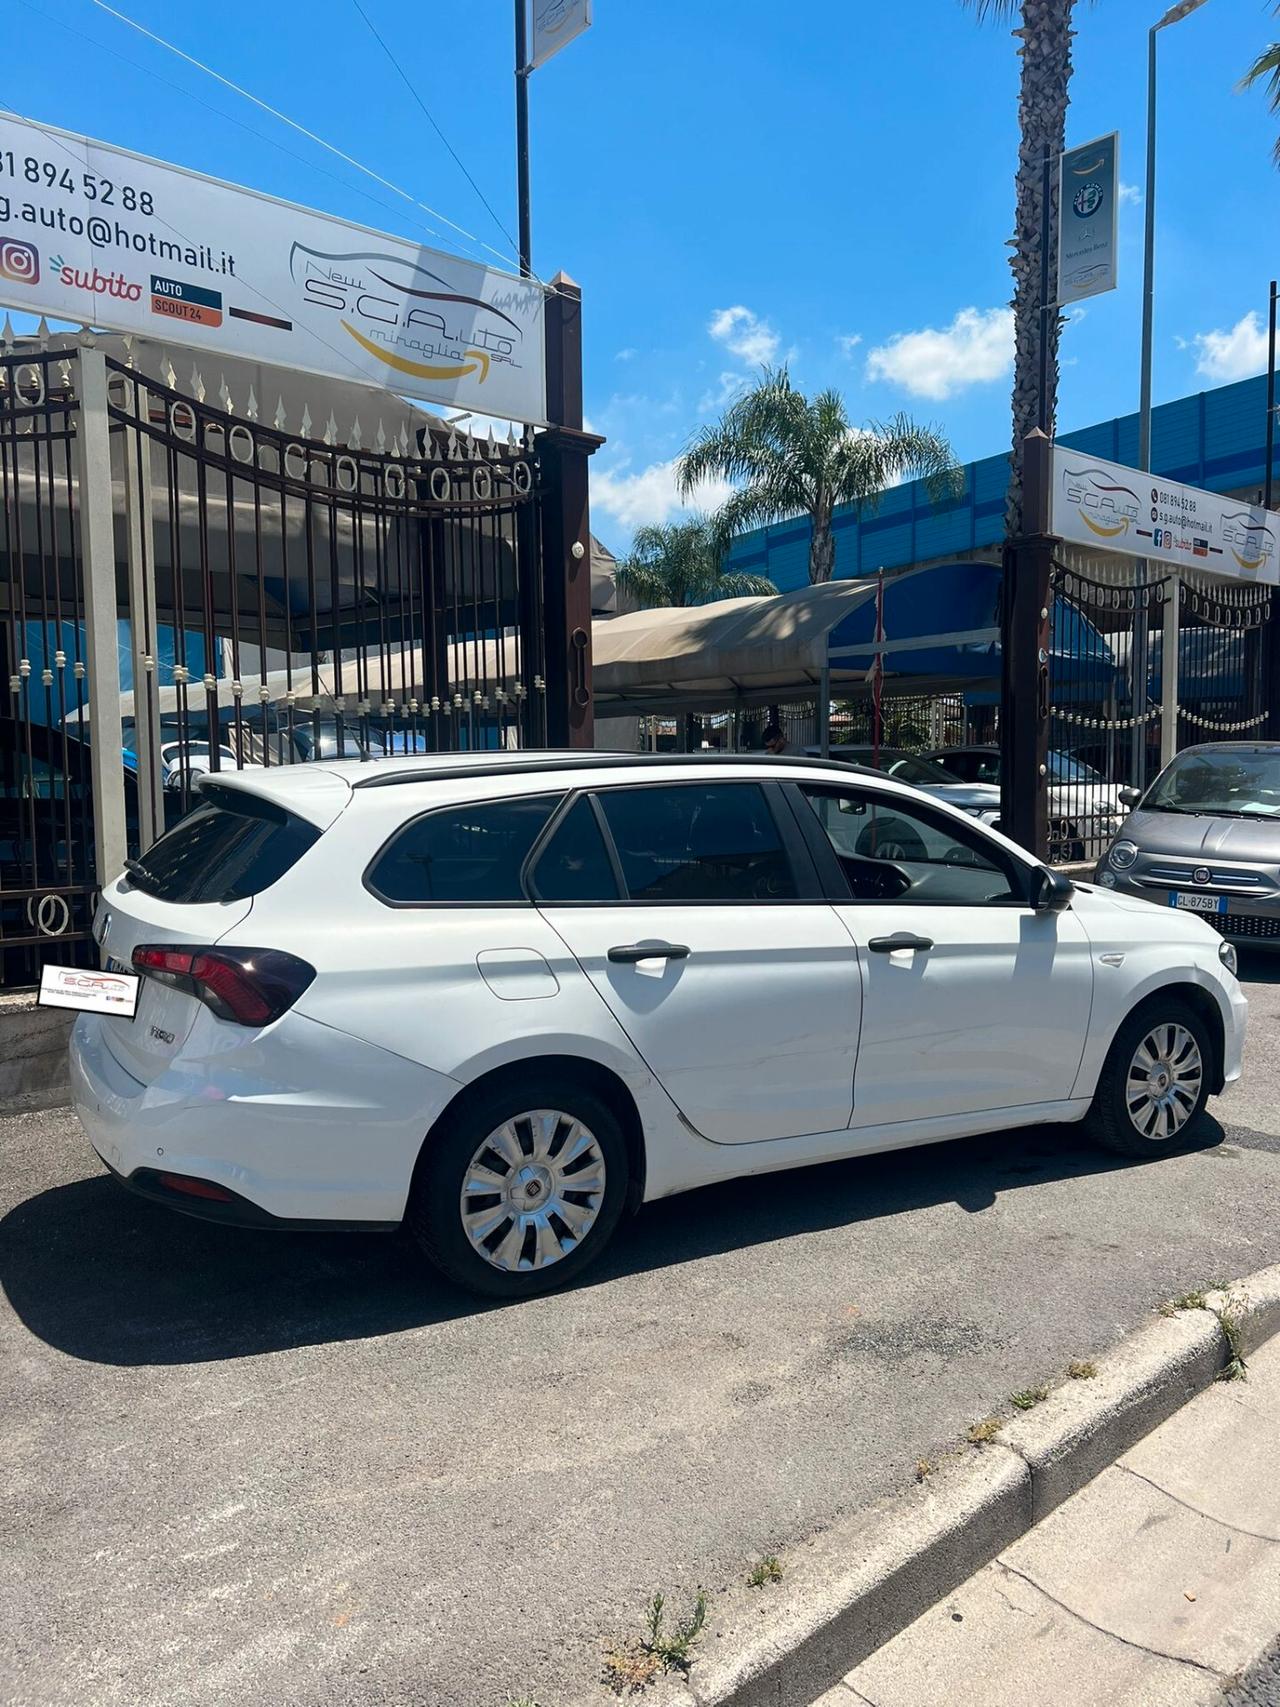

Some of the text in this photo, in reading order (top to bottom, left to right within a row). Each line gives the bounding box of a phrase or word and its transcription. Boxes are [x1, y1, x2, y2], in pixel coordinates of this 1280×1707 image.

[0, 152, 154, 215] 1 894 52 88
[60, 264, 143, 302] subito
[154, 280, 183, 297] AUTO
